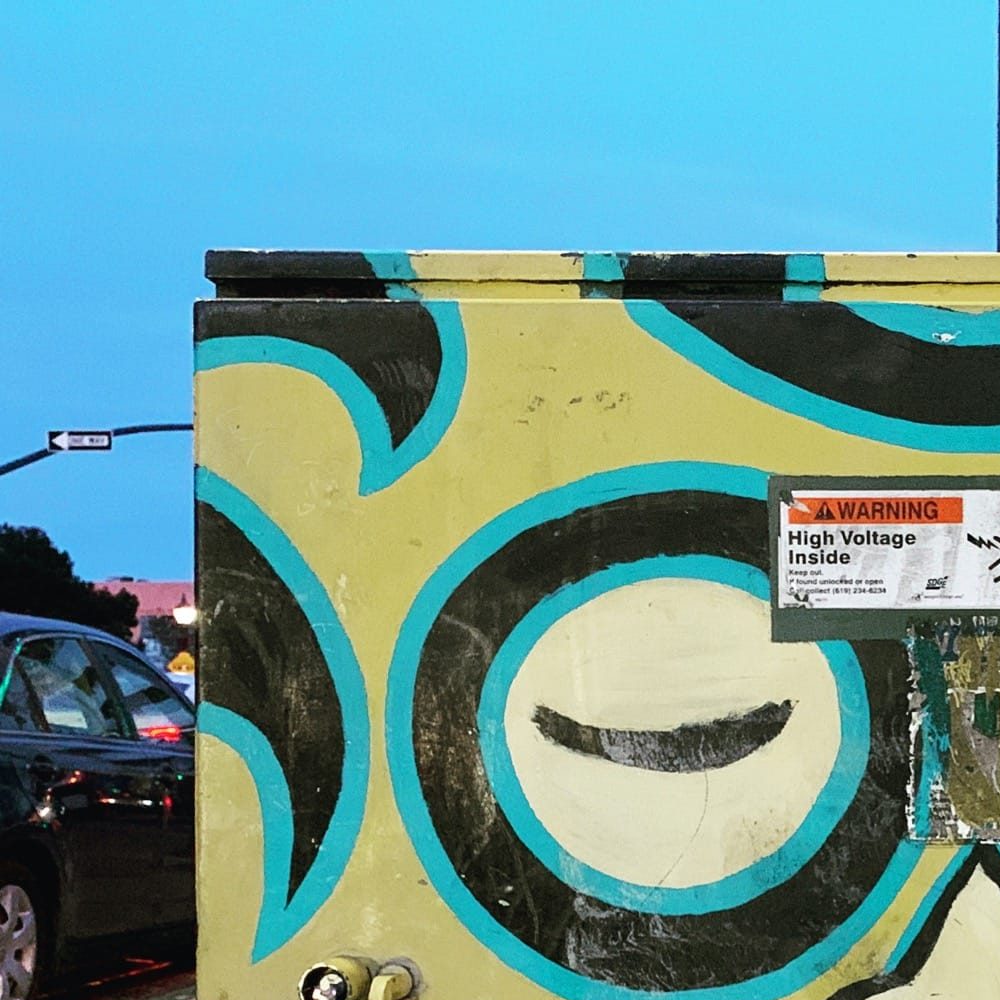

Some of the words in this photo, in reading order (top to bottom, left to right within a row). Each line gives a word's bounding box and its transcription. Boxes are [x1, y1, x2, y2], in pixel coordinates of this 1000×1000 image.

[837, 501, 939, 520] WARNING
[788, 530, 834, 549] High
[840, 530, 917, 549] Voltage
[788, 550, 851, 565] Inside
[789, 569, 808, 577] Keep
[833, 587, 851, 595] (619)
